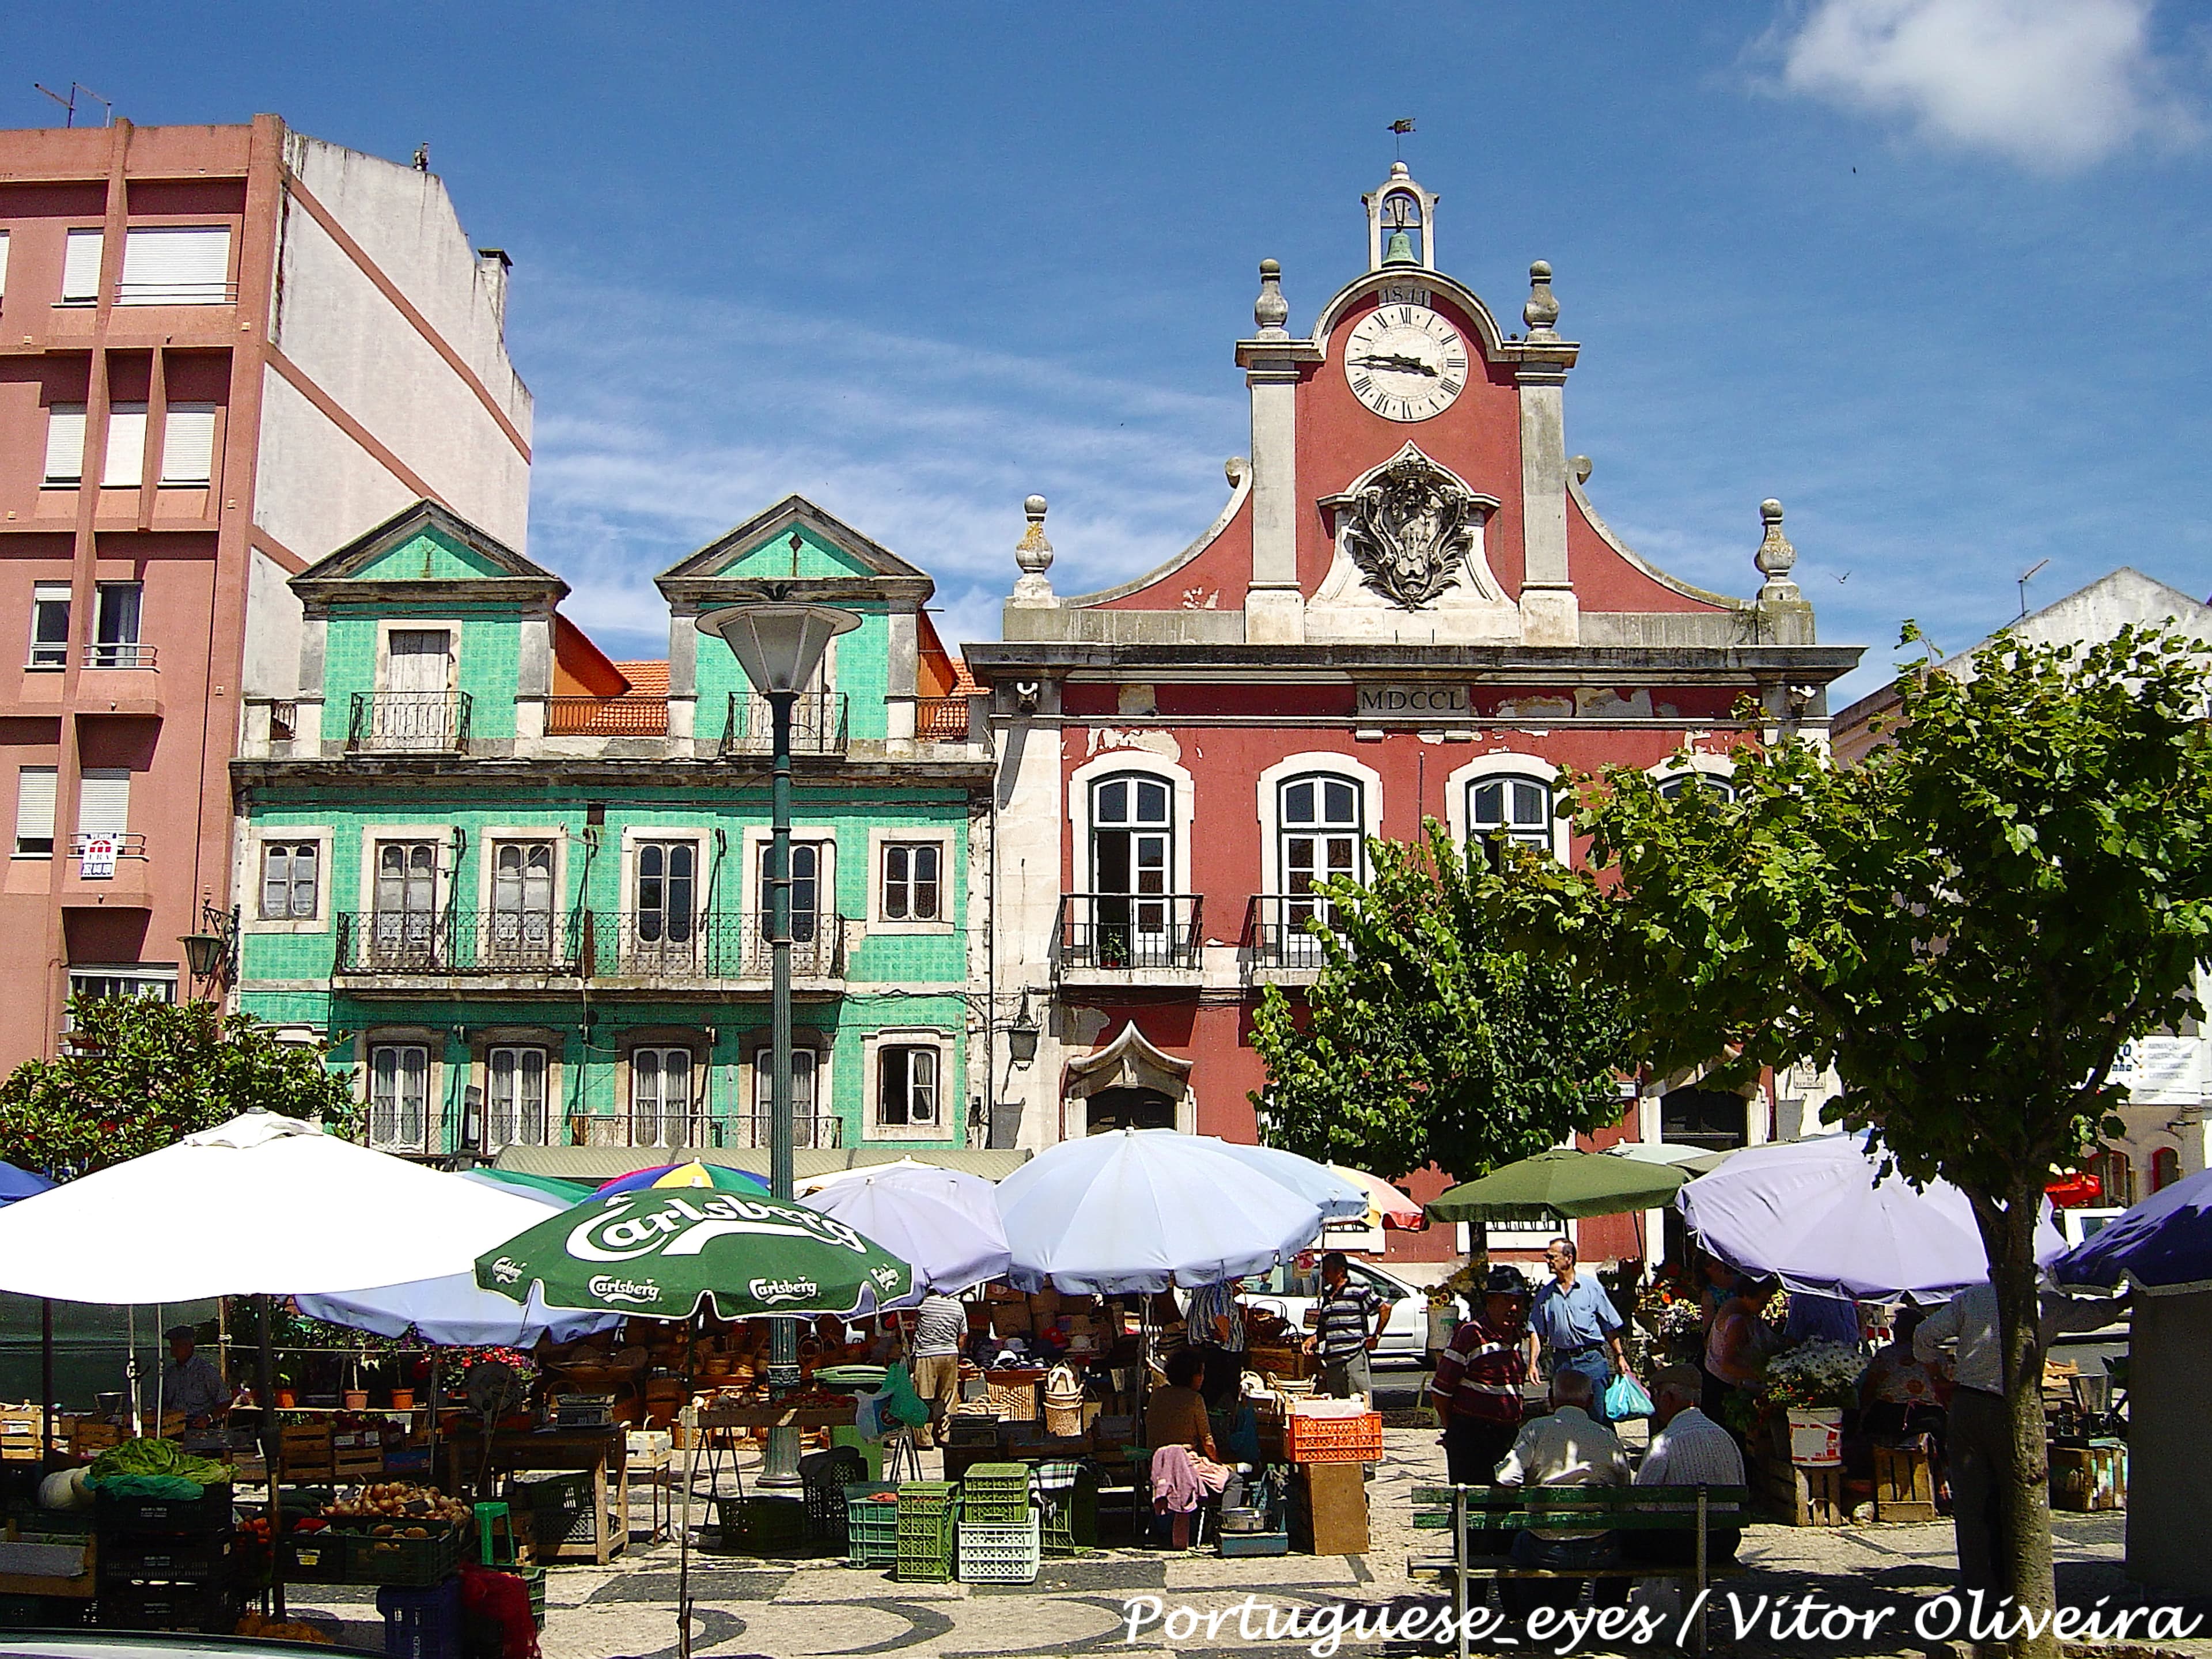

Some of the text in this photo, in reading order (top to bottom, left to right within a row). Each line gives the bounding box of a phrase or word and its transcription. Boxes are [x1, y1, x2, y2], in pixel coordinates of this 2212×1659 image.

[1362, 691, 1465, 710] MDCCL
[565, 1194, 868, 1262] Carlsberg
[588, 1274, 660, 1302] Carlsberg
[749, 1277, 817, 1300] Carlsberg
